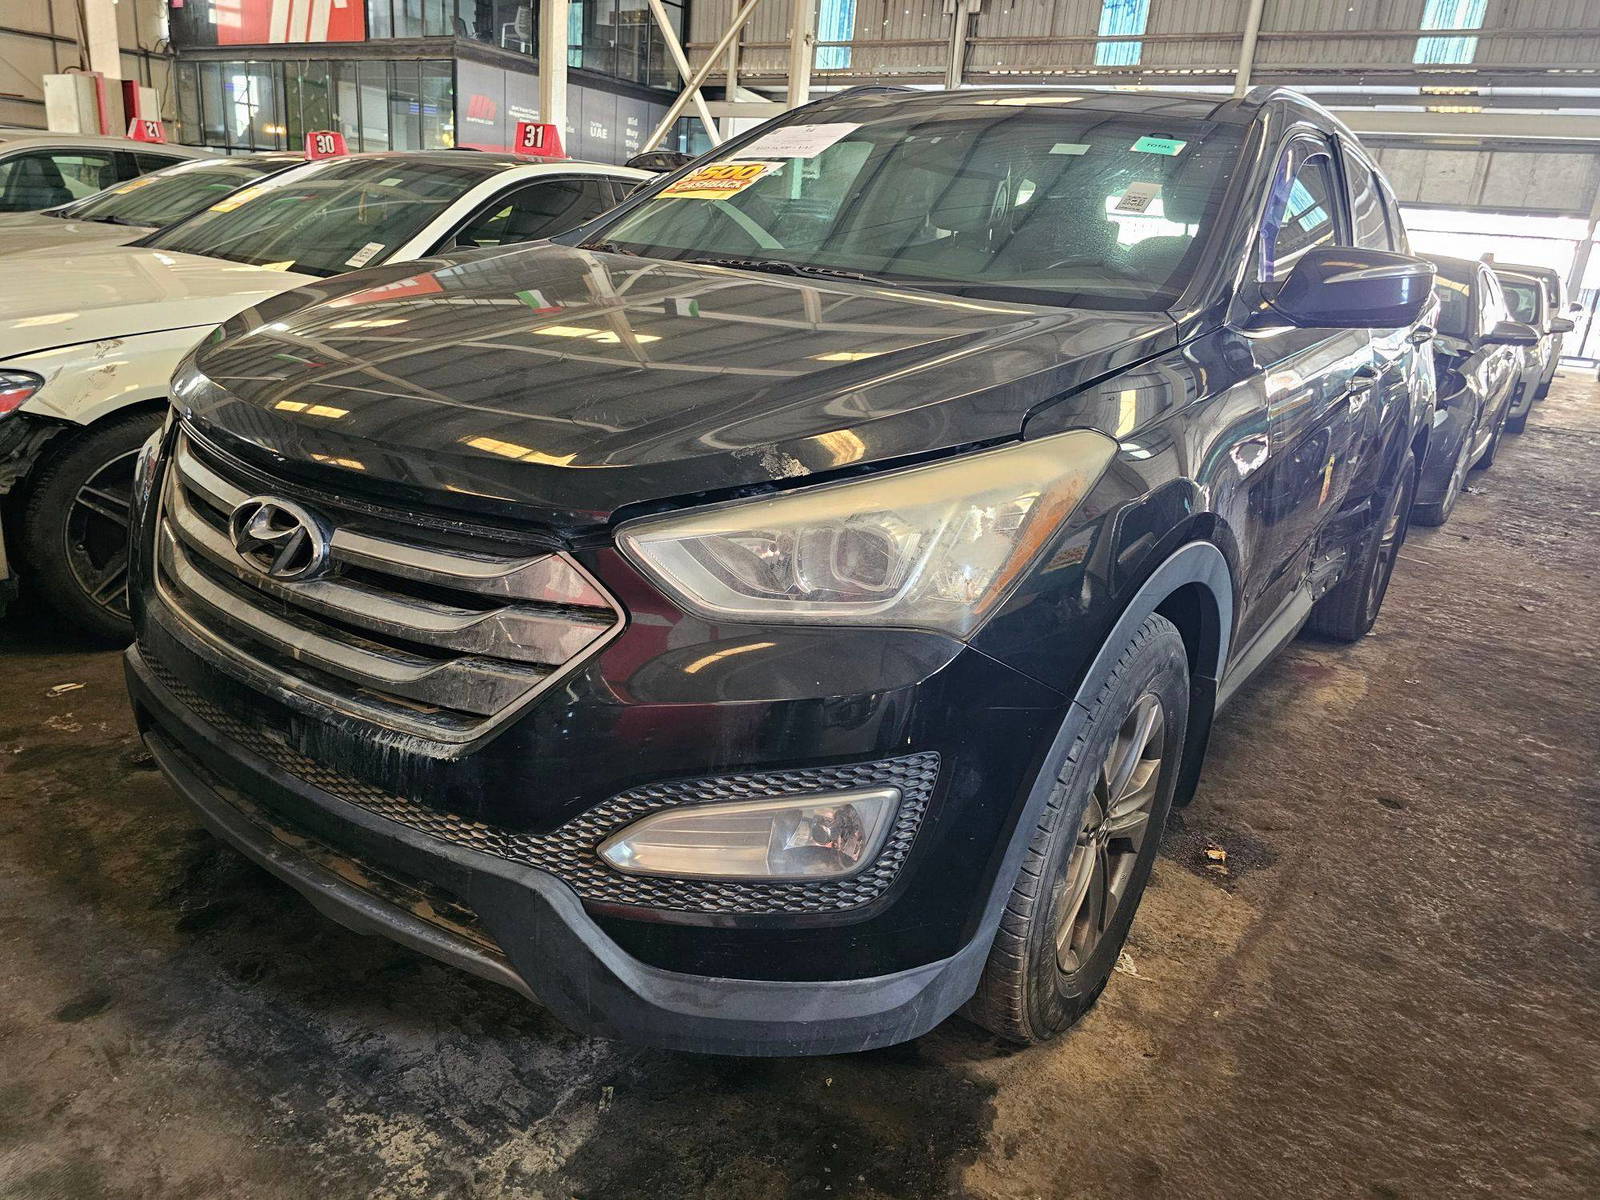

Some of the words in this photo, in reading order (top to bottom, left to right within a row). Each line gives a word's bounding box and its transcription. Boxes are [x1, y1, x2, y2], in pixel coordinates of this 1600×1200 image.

[146, 121, 160, 138] 21
[524, 125, 544, 148] 31
[590, 127, 608, 139] UAE
[316, 135, 335, 154] 30
